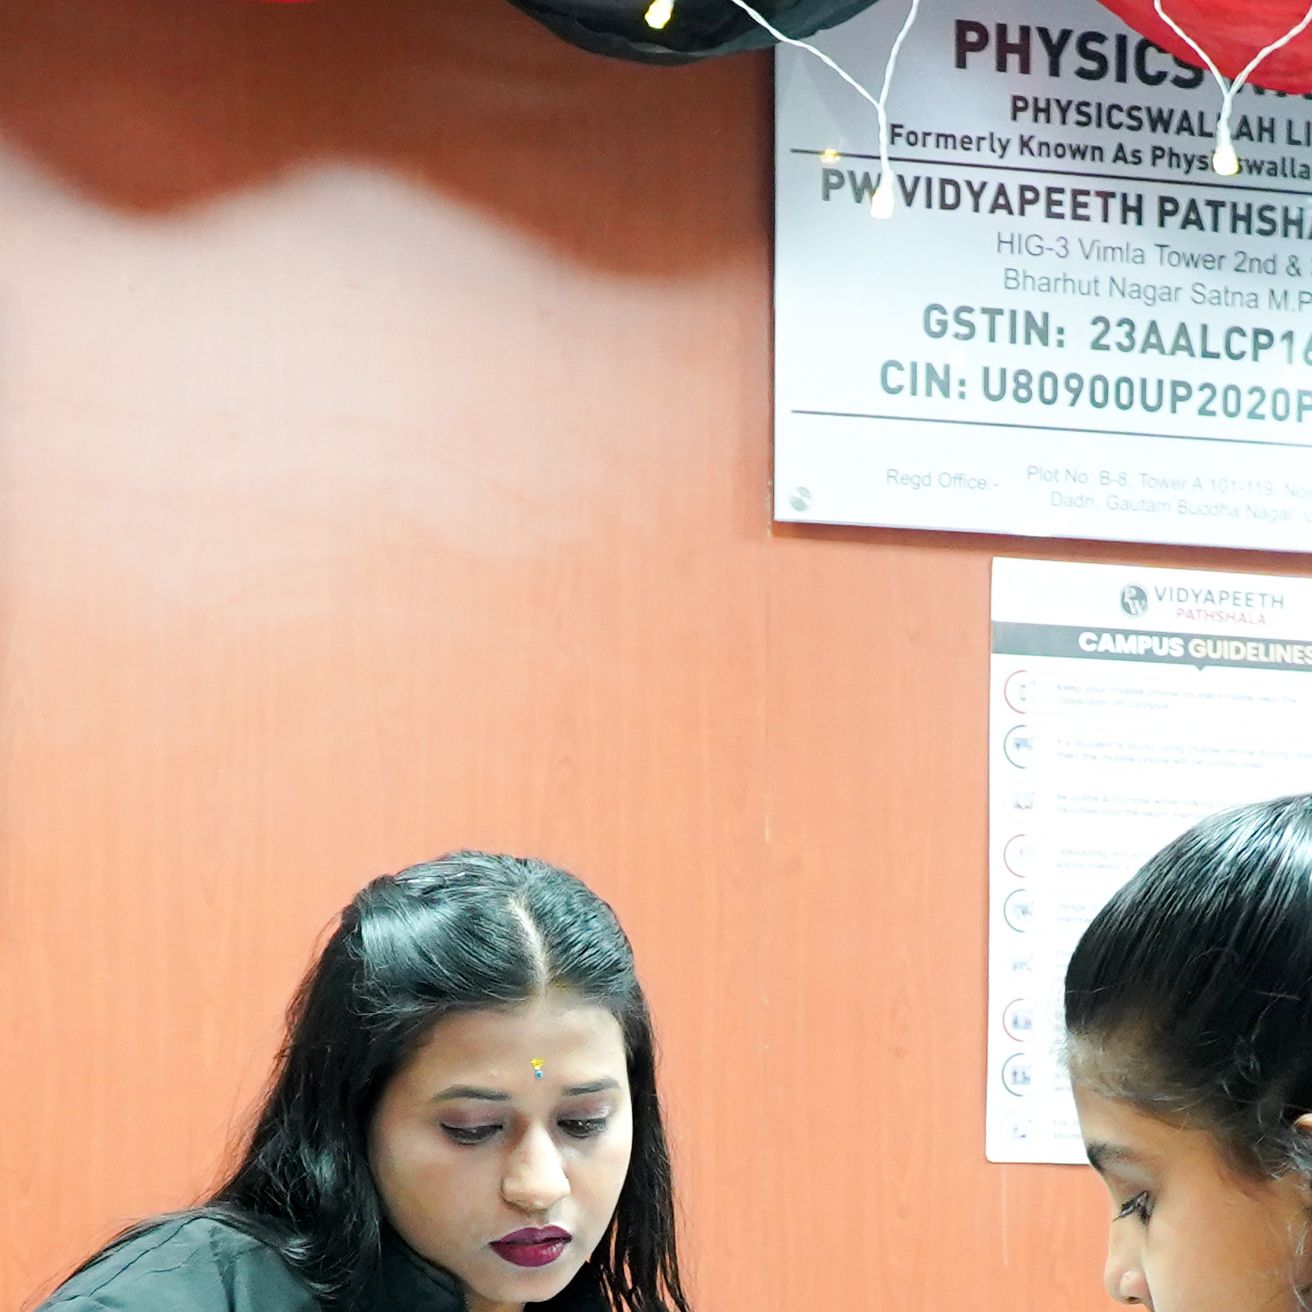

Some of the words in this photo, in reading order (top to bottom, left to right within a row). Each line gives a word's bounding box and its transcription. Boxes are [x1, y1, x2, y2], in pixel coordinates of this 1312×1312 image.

[1010, 94, 1275, 144] PHYSICSWALAH
[889, 123, 1011, 159] Formerly
[1019, 134, 1105, 164] Known
[1113, 141, 1142, 166] As
[897, 174, 1144, 227] VIDYAPEETH
[996, 231, 1070, 259] HIG-3
[1079, 236, 1145, 266] Vimla
[1153, 243, 1226, 272] Tower
[1233, 250, 1277, 276] 2nd
[1285, 254, 1302, 278] &
[1004, 267, 1100, 298] Bharhut
[1109, 276, 1182, 308] Nagar
[1190, 282, 1260, 311] Satna
[922, 302, 1065, 349] GSTIN:
[880, 359, 966, 400] CIN:
[886, 467, 932, 490] Regd
[1026, 464, 1059, 482] Plot
[1139, 471, 1188, 490] Tower
[1192, 476, 1204, 491] A
[1106, 493, 1171, 513] Gautam
[1177, 498, 1240, 519] Buddha
[1154, 585, 1285, 610] VIDYAPEETH
[1176, 607, 1267, 625] PATHSHALA
[1078, 631, 1185, 658] CAMPUS
